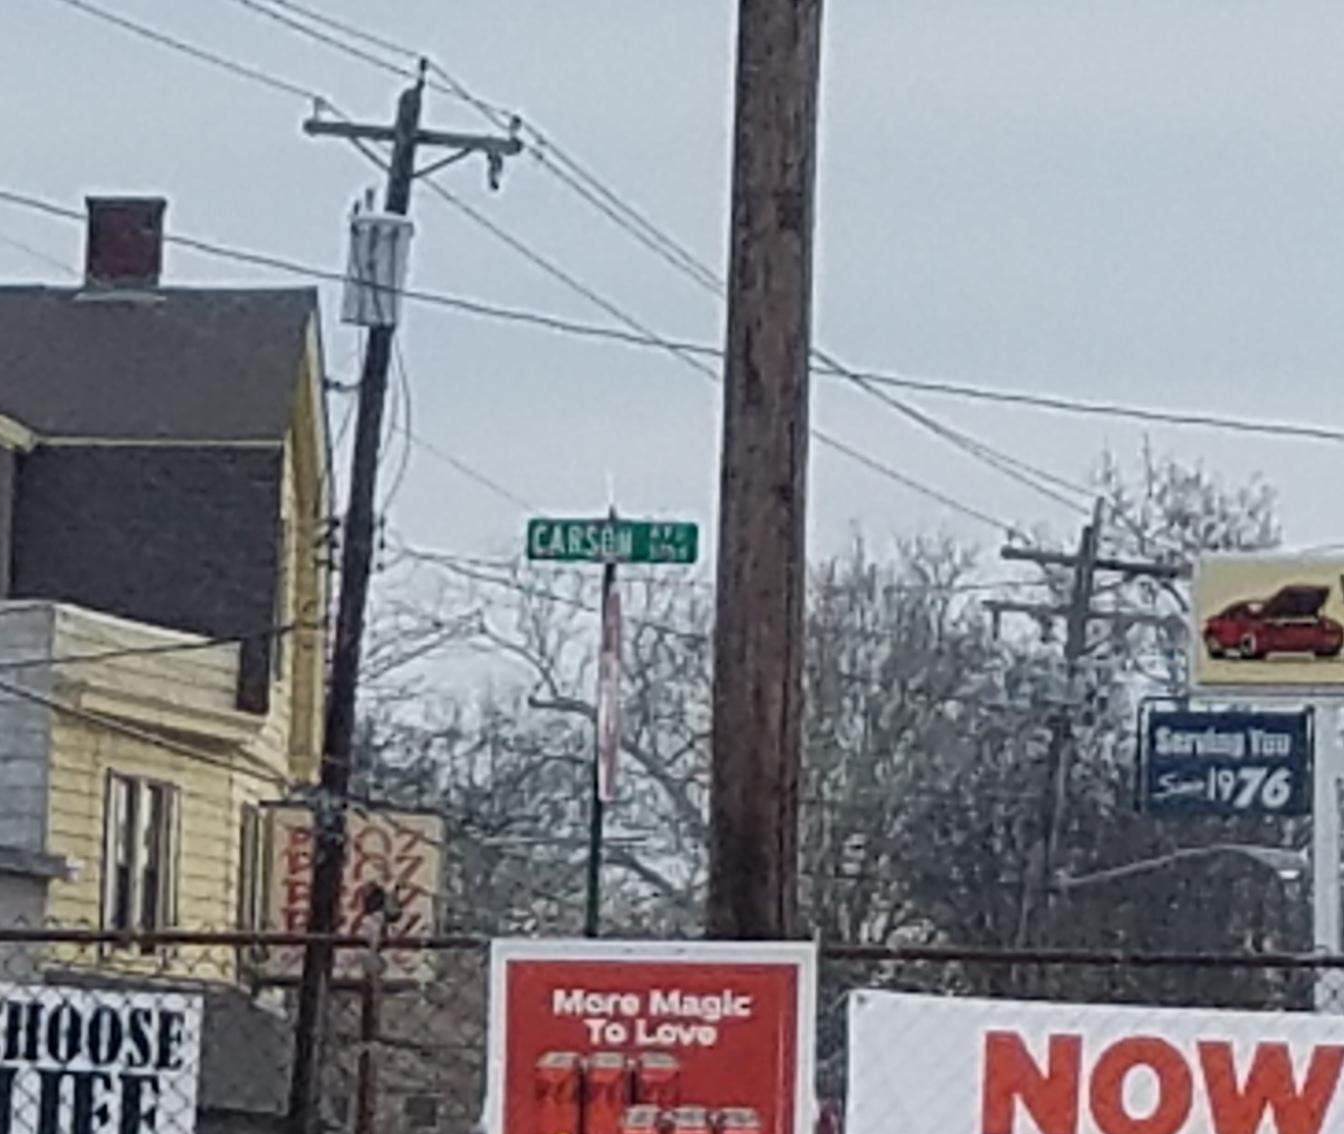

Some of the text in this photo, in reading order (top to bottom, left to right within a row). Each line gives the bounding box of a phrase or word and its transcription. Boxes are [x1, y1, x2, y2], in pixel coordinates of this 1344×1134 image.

[531, 524, 633, 557] CARSON
[1207, 766, 1292, 809] 1976
[552, 988, 753, 1020] More Magic
[584, 1018, 718, 1046] To Love
